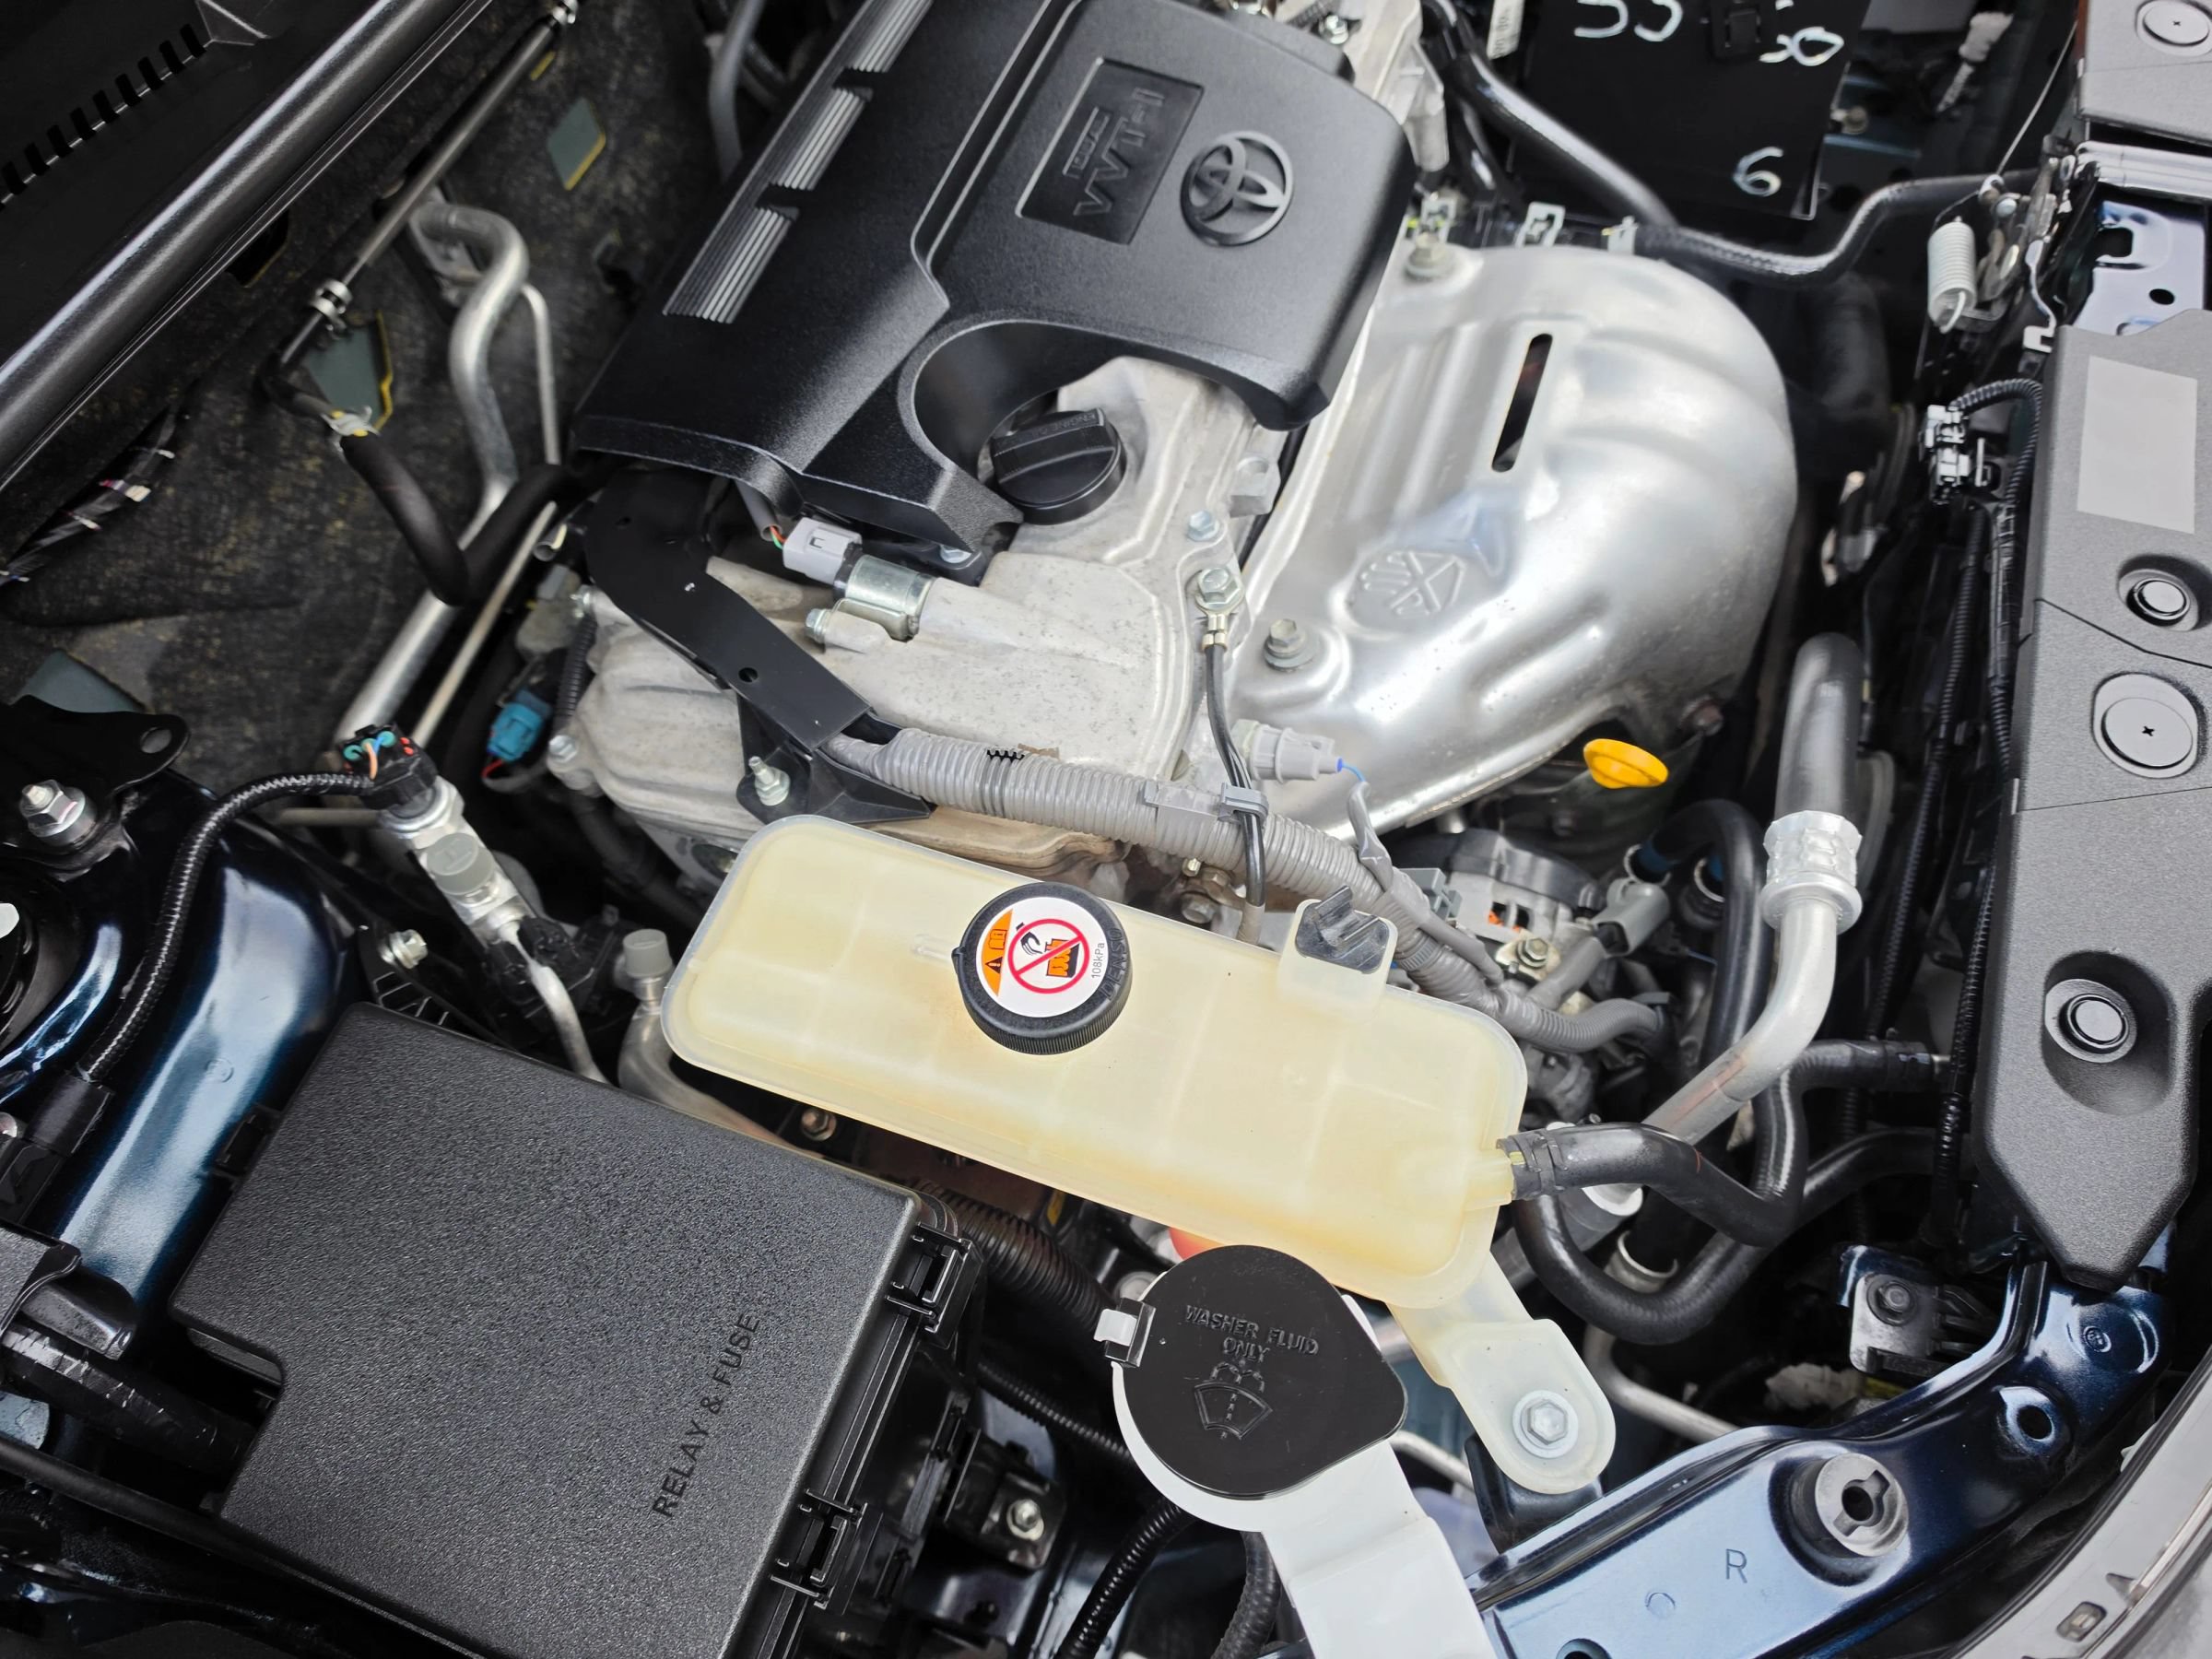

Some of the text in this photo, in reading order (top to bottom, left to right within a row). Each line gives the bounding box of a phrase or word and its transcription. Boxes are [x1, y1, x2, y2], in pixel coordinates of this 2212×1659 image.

[1733, 146, 1783, 197] 6
[1091, 942, 1106, 979] 108kPa
[1100, 926, 1127, 1002] DENSO
[1185, 1304, 1320, 1356] WASHER FLUID
[1222, 1336, 1271, 1364] ONLY
[652, 1313, 760, 1518] RELAY & FUSE
[1725, 1548, 1748, 1583] R
